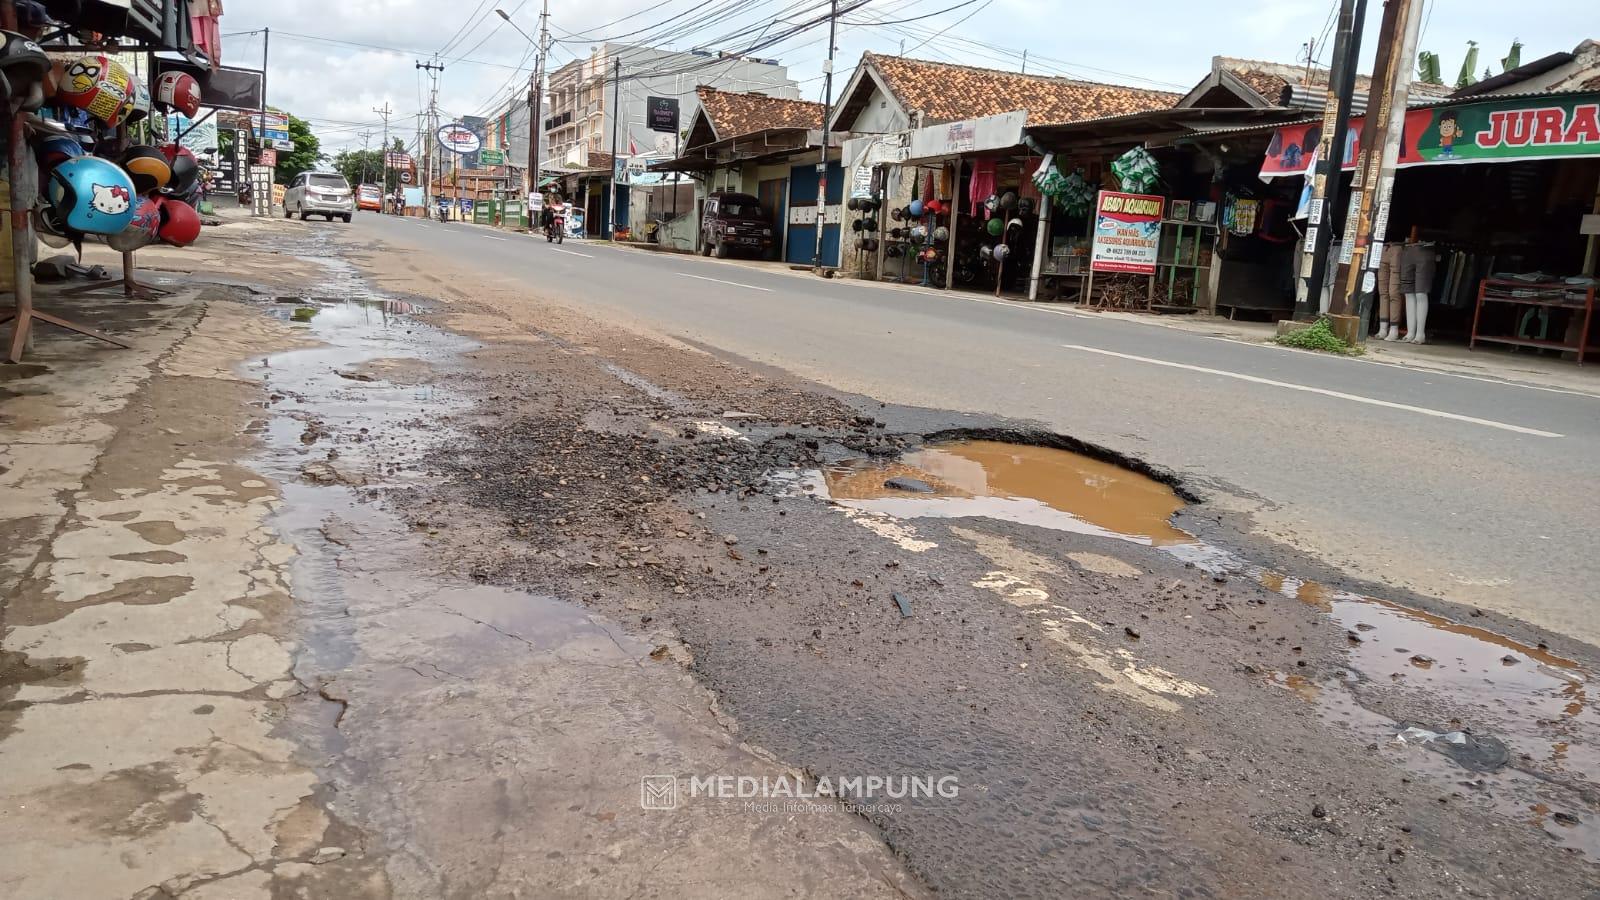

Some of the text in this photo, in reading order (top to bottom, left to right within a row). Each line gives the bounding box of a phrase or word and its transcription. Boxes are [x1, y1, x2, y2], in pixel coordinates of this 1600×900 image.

[1476, 105, 1600, 148] JURA
[251, 174, 260, 215] MOBIL
[260, 173, 269, 215] MOTOR
[1101, 196, 1161, 216] ABADI AQUARIUM
